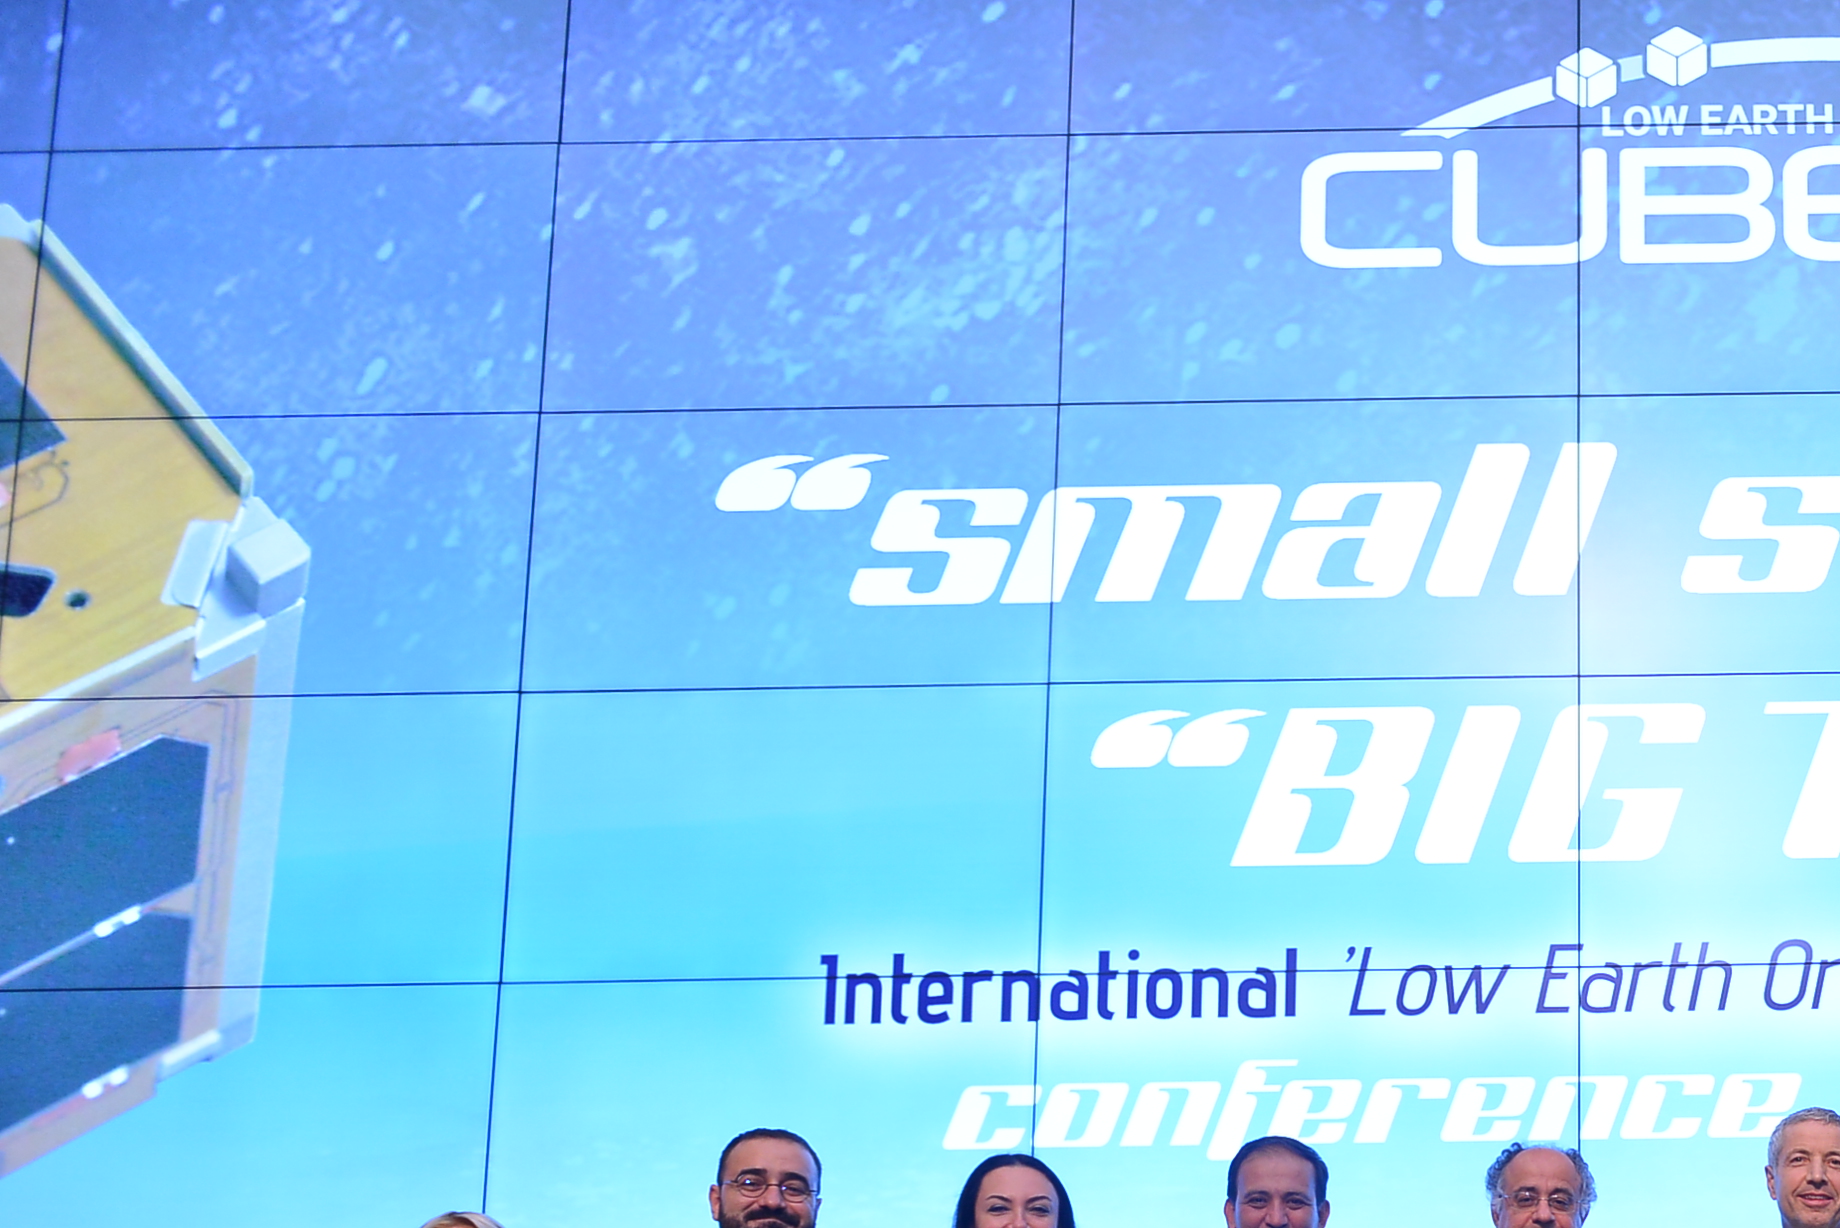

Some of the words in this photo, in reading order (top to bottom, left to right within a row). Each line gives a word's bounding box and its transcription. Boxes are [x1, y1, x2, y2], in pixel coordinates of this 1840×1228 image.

[1601, 105, 1690, 138] LOW
[1699, 103, 1833, 137] EARTH
[820, 948, 1299, 1025] International
[1535, 942, 1731, 1015] Earth
[941, 1058, 1806, 1162] conference
